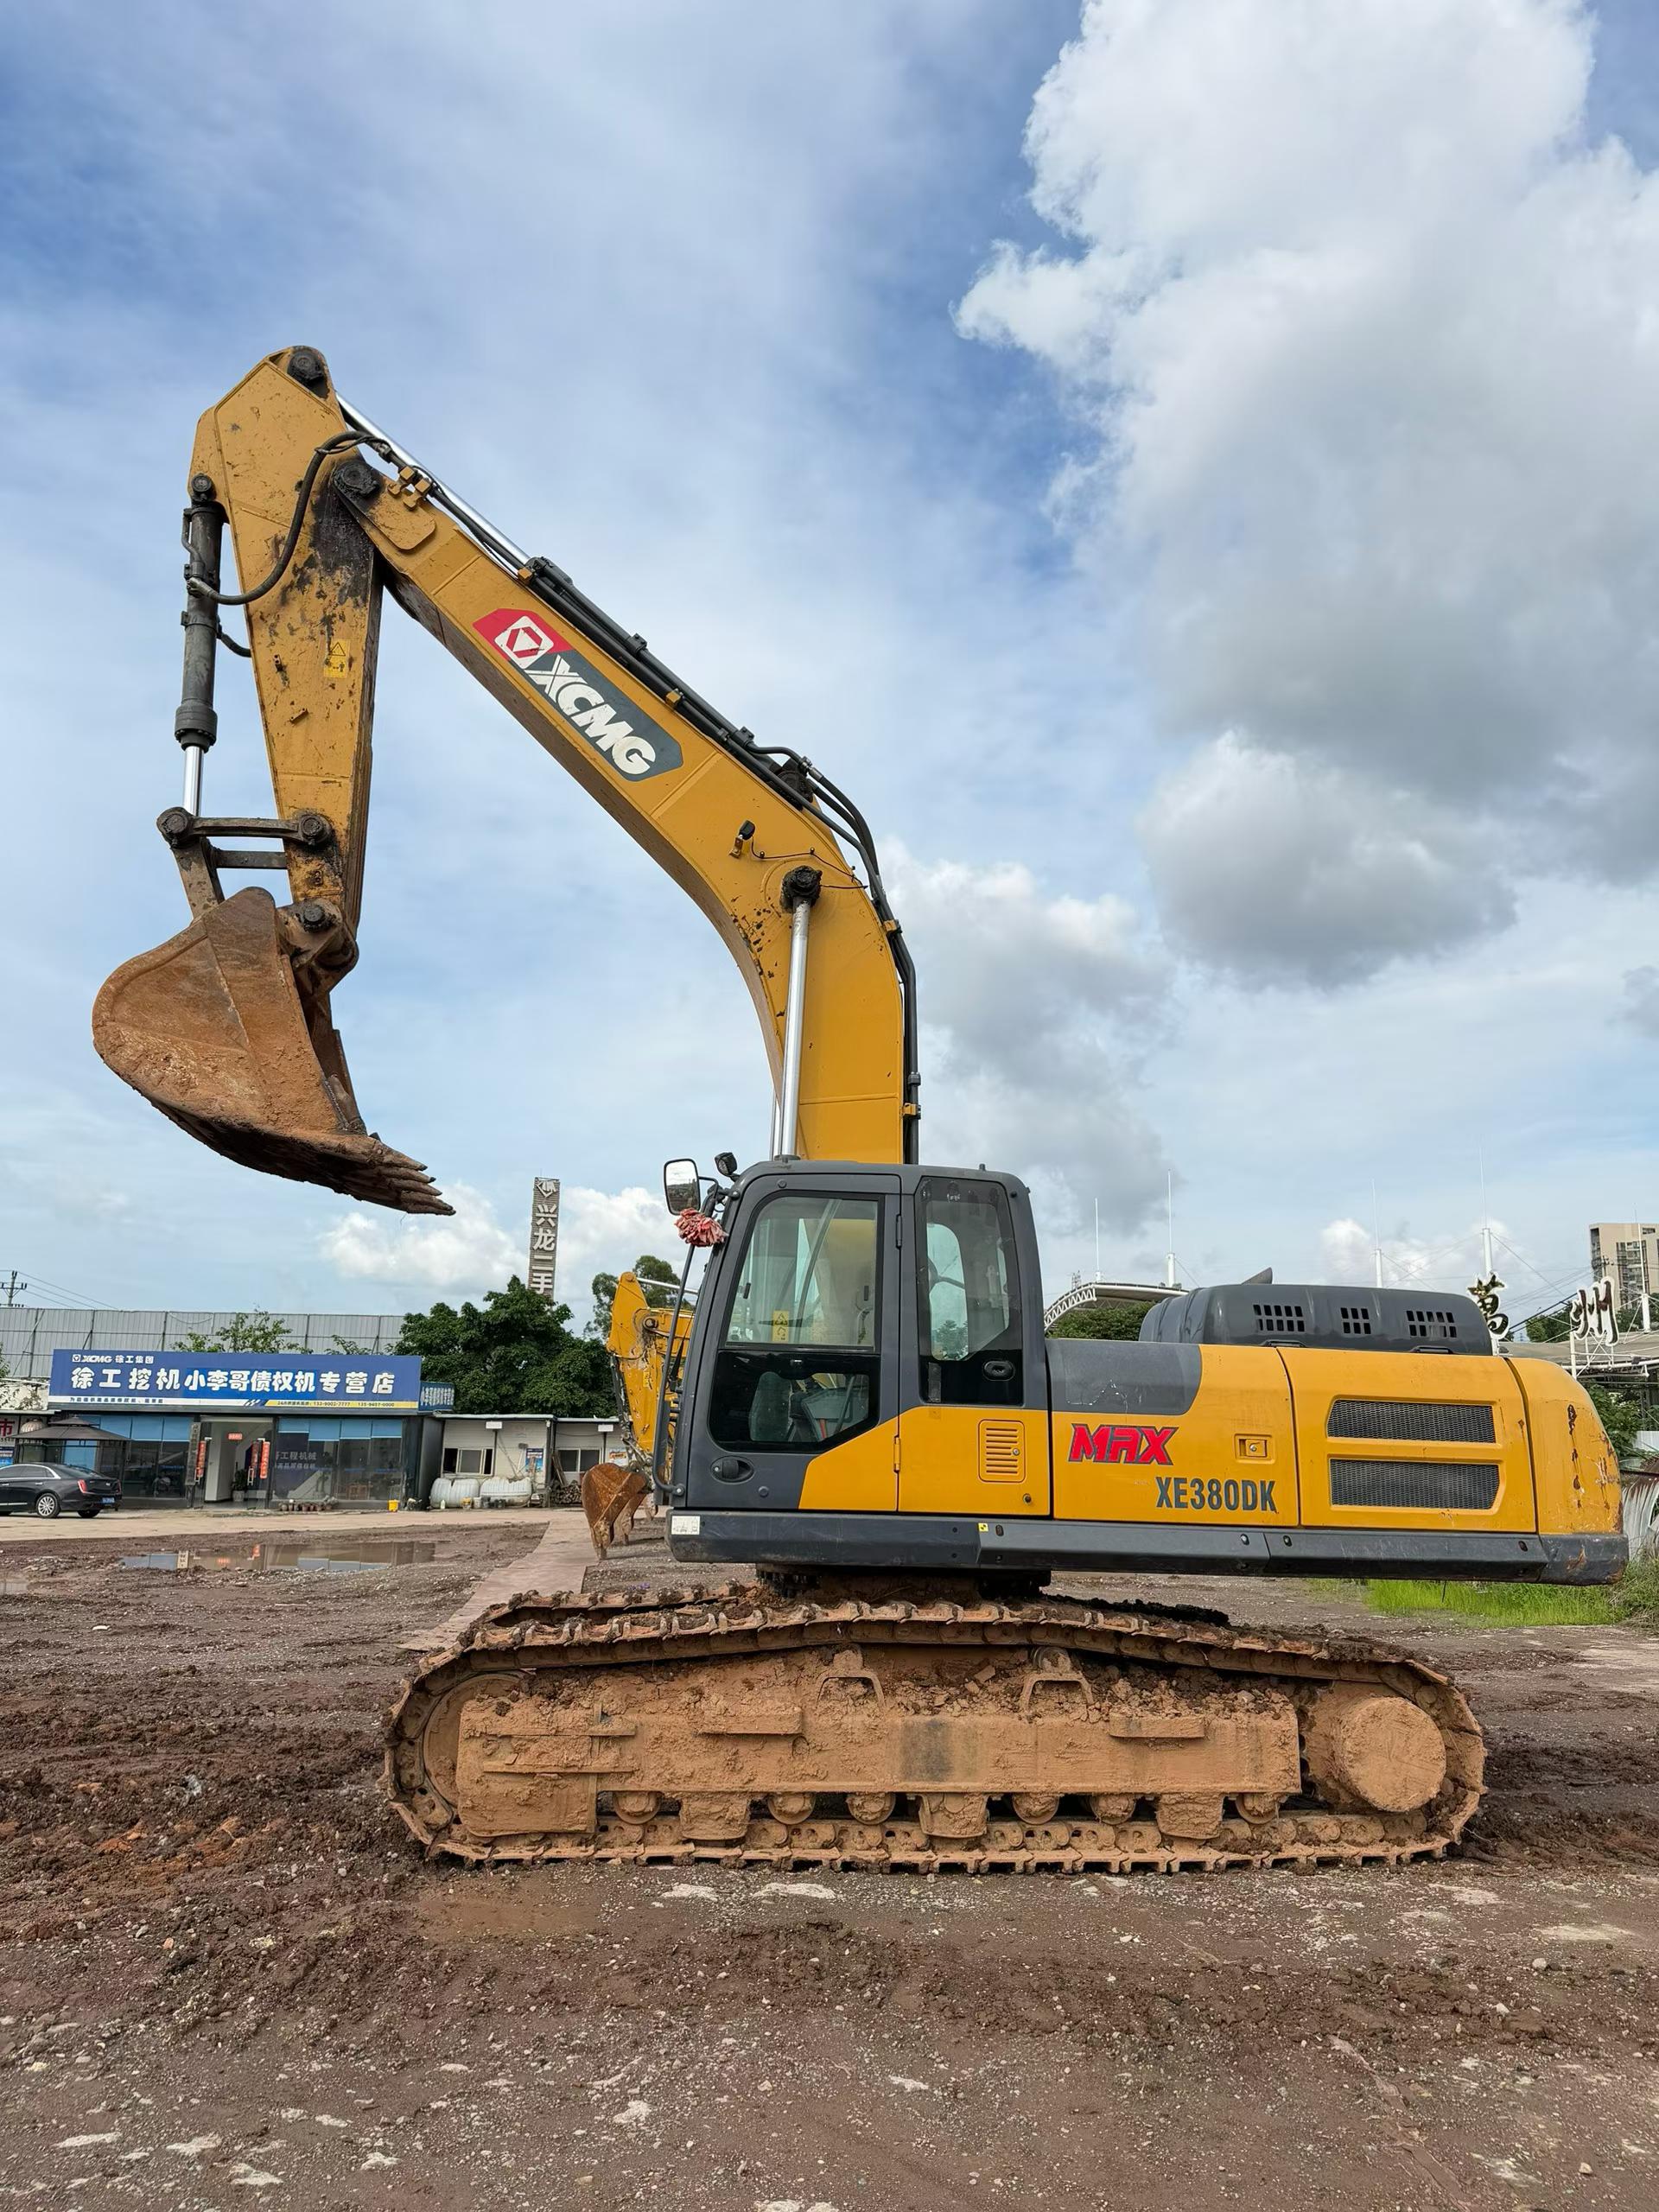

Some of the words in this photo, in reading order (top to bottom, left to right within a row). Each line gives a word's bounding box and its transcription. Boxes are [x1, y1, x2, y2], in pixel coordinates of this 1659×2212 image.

[524, 654, 657, 775] XCMG
[531, 1204, 557, 1294] 兴龙二手
[81, 1355, 112, 1363] XCMG
[115, 1355, 154, 1364] 徐工集团
[71, 1366, 395, 1394] 徐工挖机小李哥债权机专营店
[1068, 1423, 1179, 1465] MAX
[1155, 1476, 1276, 1512] XE380DK
